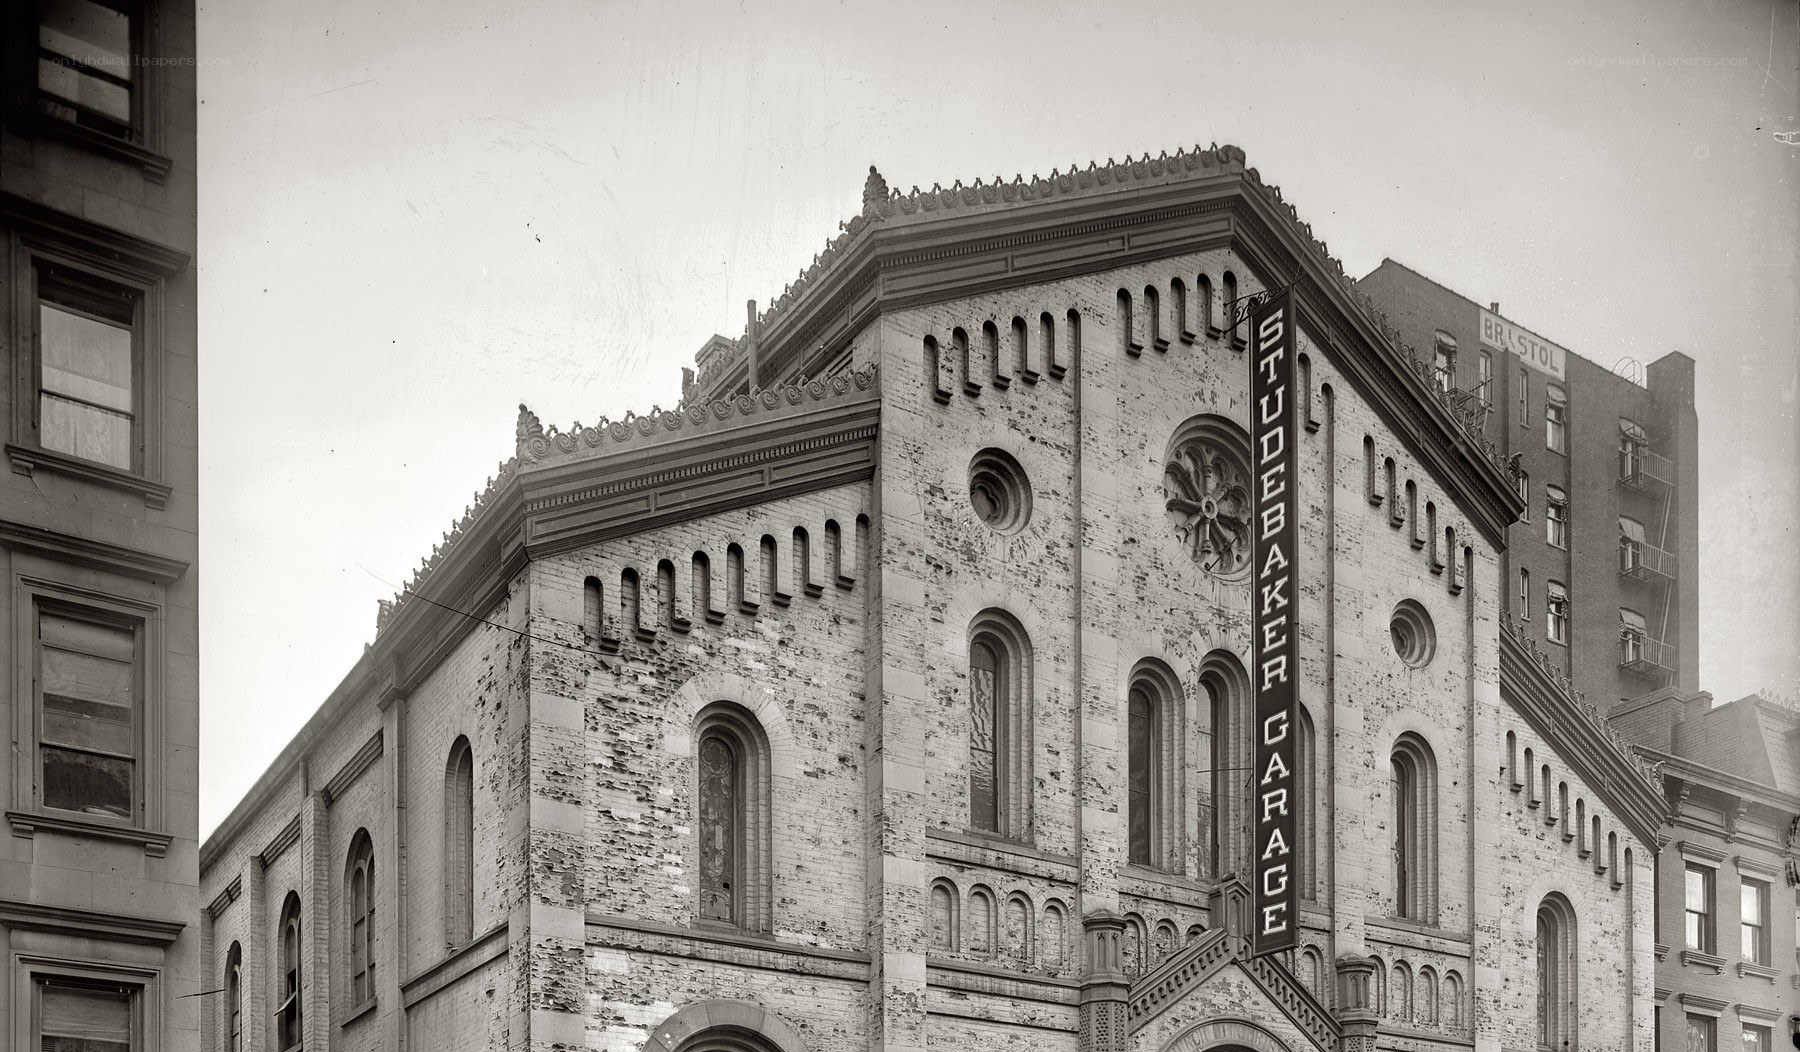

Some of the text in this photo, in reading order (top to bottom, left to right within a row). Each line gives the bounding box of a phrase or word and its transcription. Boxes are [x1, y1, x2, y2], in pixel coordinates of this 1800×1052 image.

[1483, 317, 1560, 373] BRISTOL
[1259, 307, 1290, 936] STUDEBAKER GARAGE
